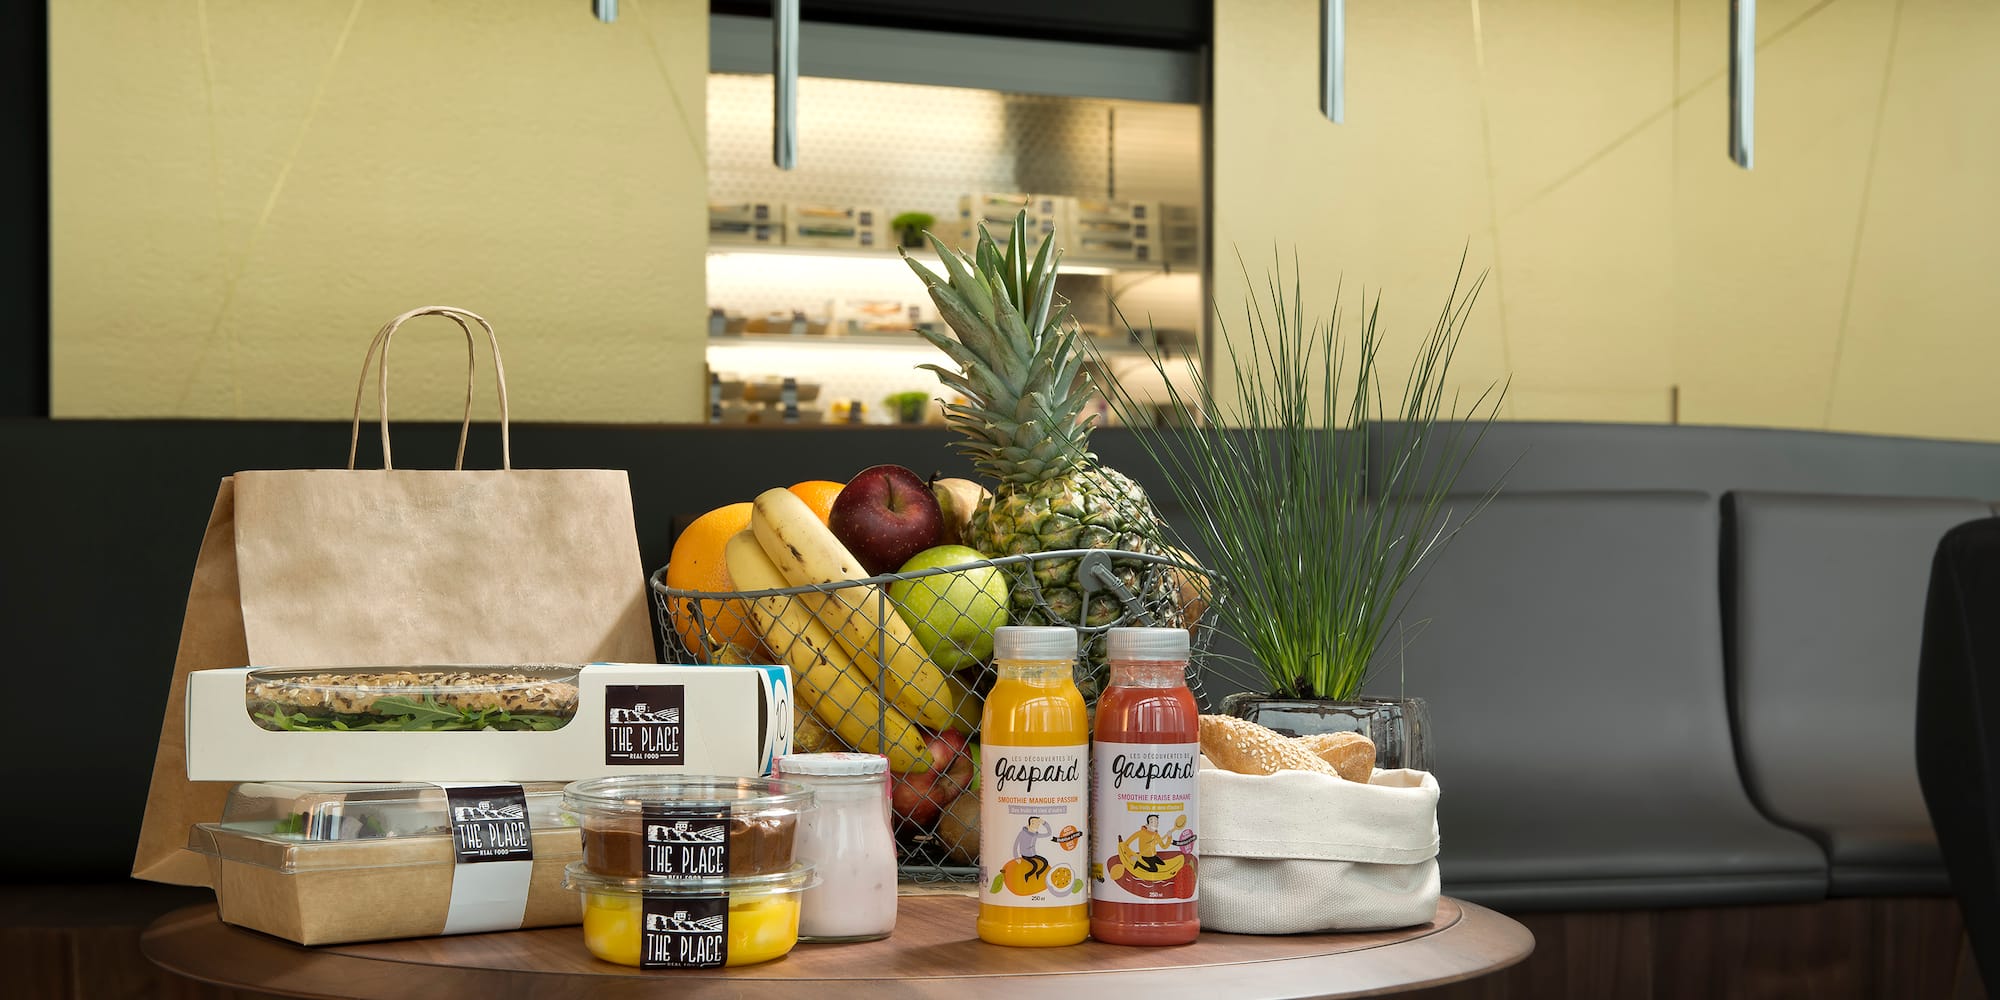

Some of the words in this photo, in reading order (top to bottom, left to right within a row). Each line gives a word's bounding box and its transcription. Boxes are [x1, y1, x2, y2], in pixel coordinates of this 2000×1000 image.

[610, 726, 633, 752] THE
[641, 726, 679, 752] PLACE
[998, 796, 1027, 804] SMOOTHIE
[1117, 793, 1148, 801] SMOOTHIE
[457, 823, 483, 849] THE
[488, 821, 527, 848] PLACE
[648, 844, 673, 873] THE
[682, 845, 725, 874] PLACE
[647, 933, 671, 962] THE
[680, 935, 723, 963] PLACE
